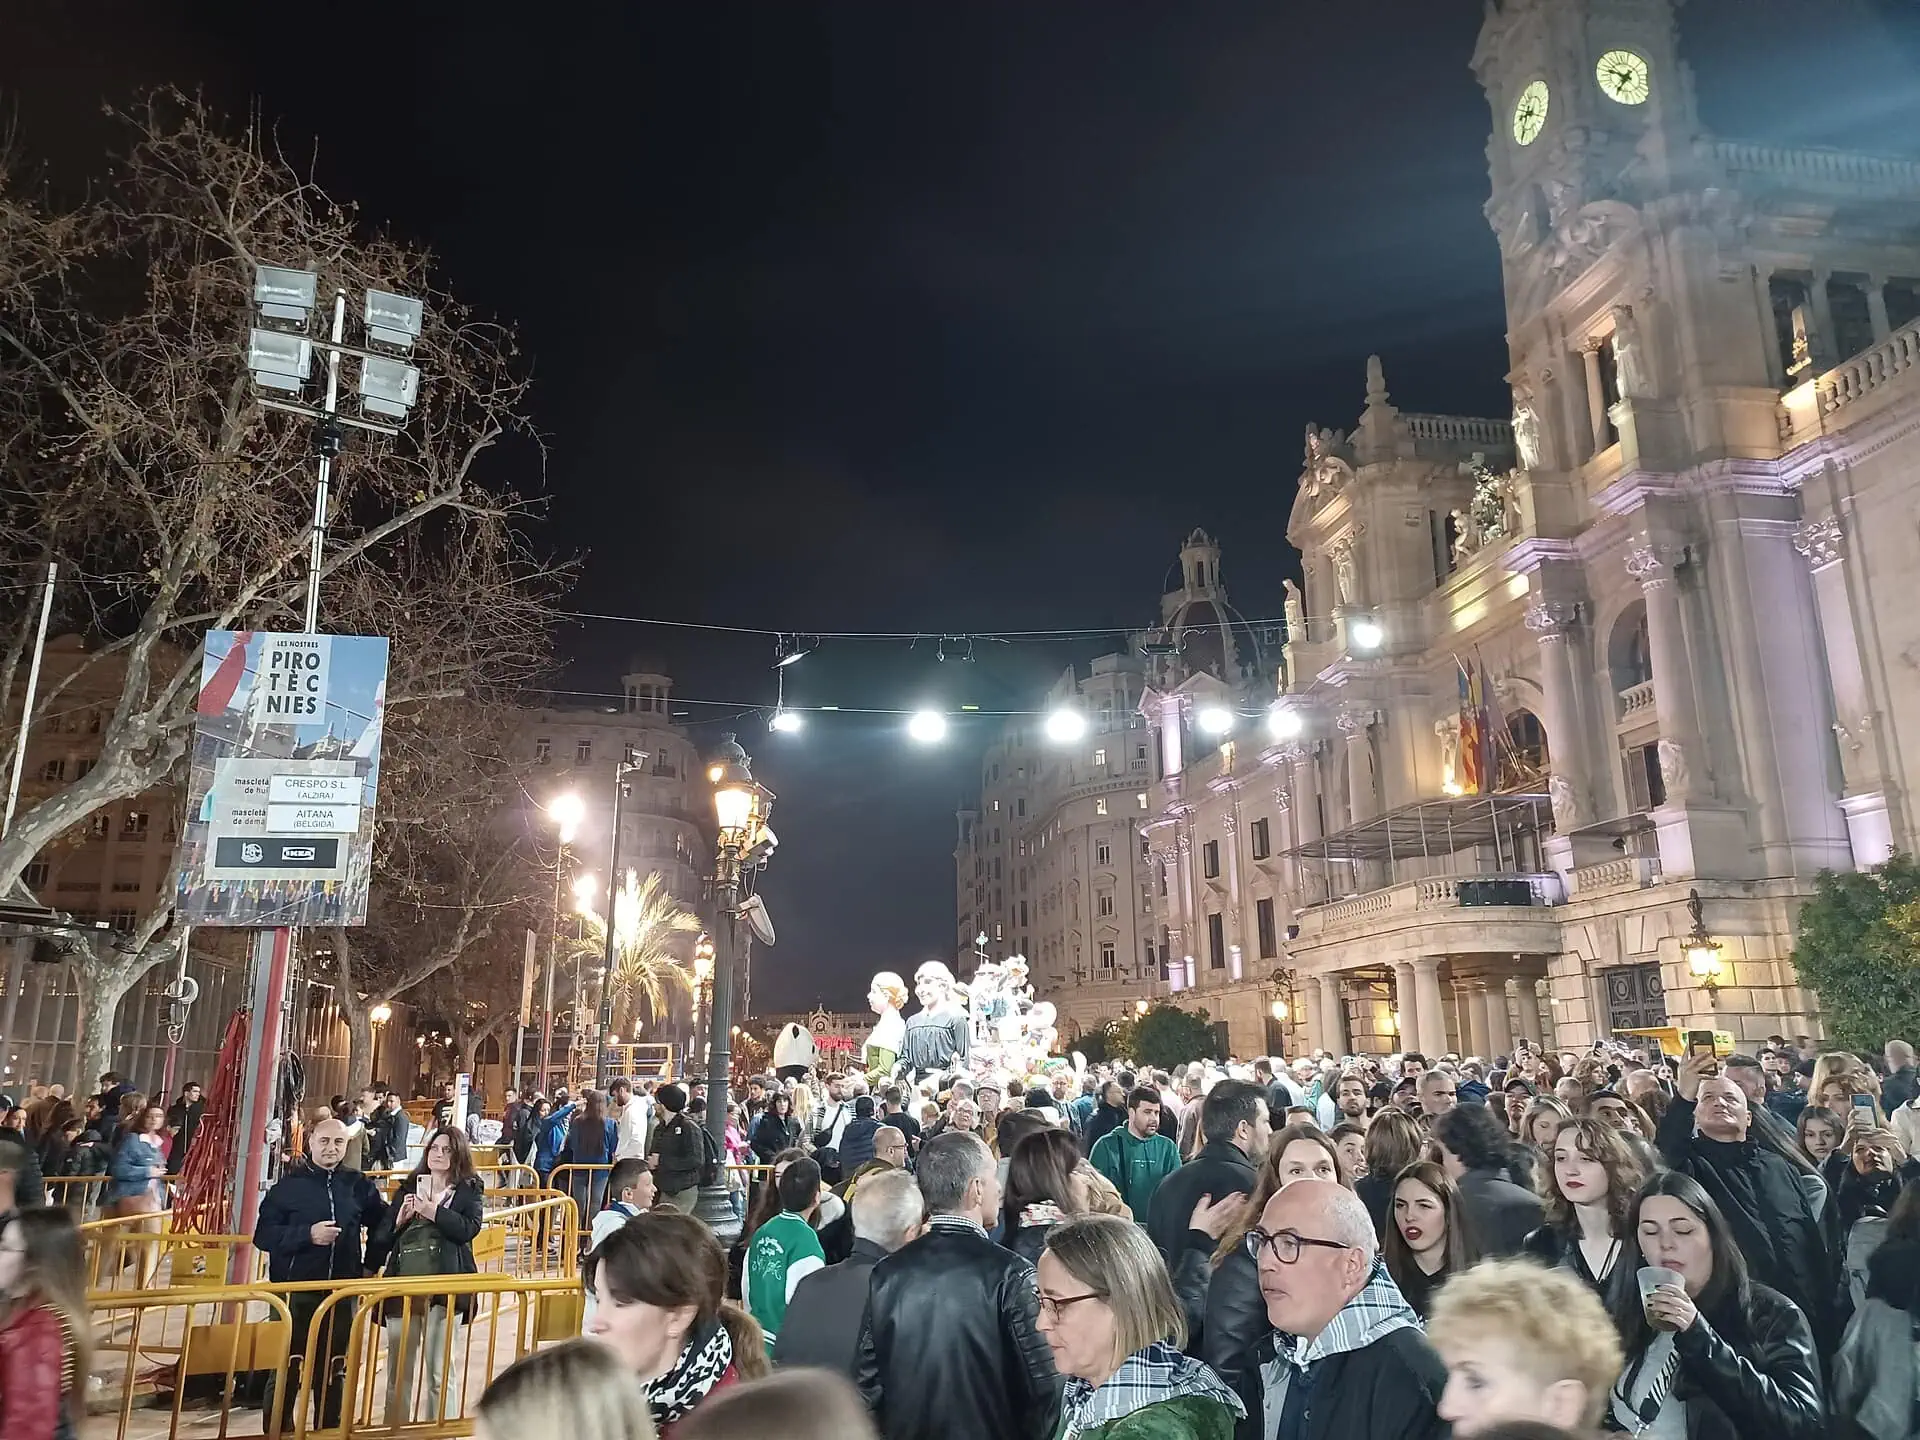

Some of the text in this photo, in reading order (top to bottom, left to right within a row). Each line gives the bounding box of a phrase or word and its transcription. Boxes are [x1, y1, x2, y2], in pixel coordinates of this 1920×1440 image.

[289, 640, 319, 648] NOSTRES
[271, 651, 320, 670] PIRO
[266, 695, 317, 715] NIES
[284, 778, 328, 789] CRESPO
[296, 809, 334, 819] AITANA
[232, 817, 242, 825] de
